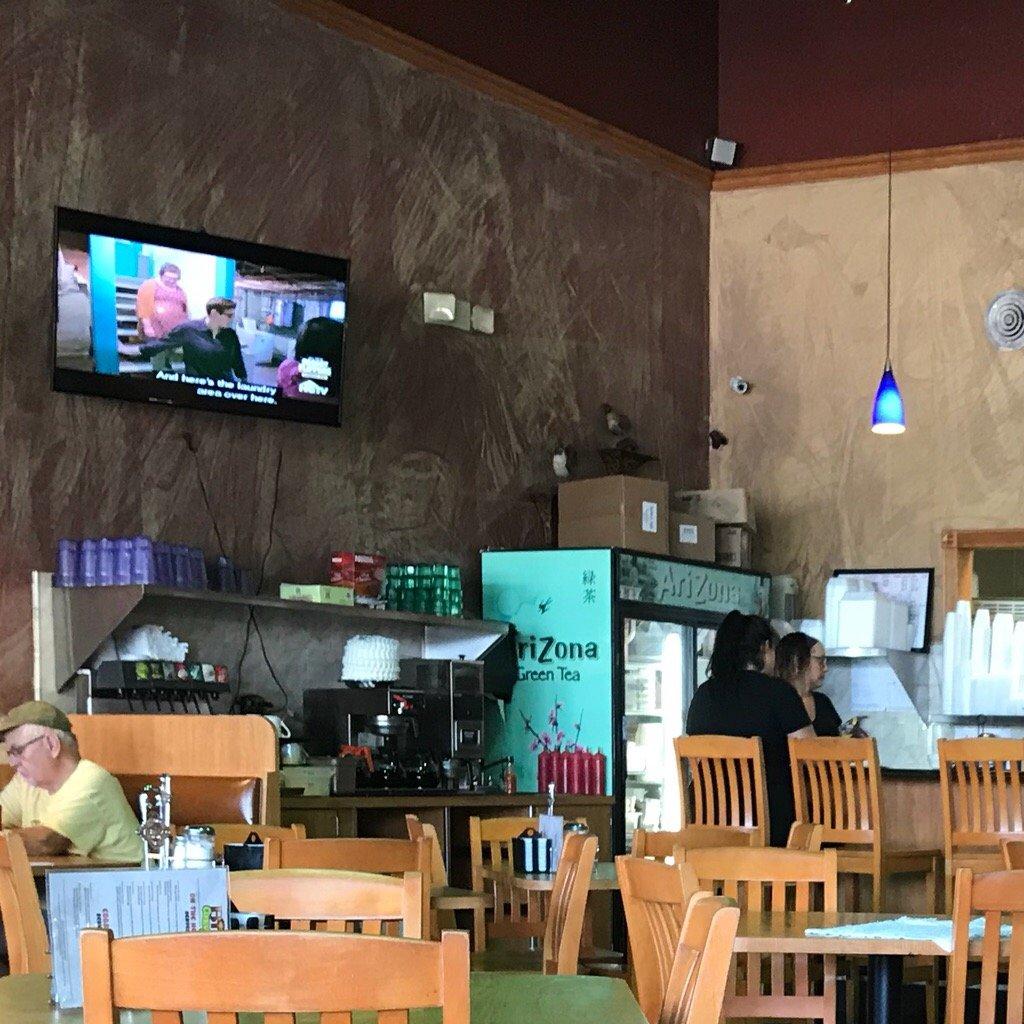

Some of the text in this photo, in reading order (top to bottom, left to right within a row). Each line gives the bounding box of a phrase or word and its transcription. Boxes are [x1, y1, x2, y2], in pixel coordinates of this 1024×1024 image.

[156, 371, 277, 396] And here's the laundry
[196, 388, 278, 405] area over here.
[517, 635, 598, 664] riZona
[557, 665, 581, 682] Tea
